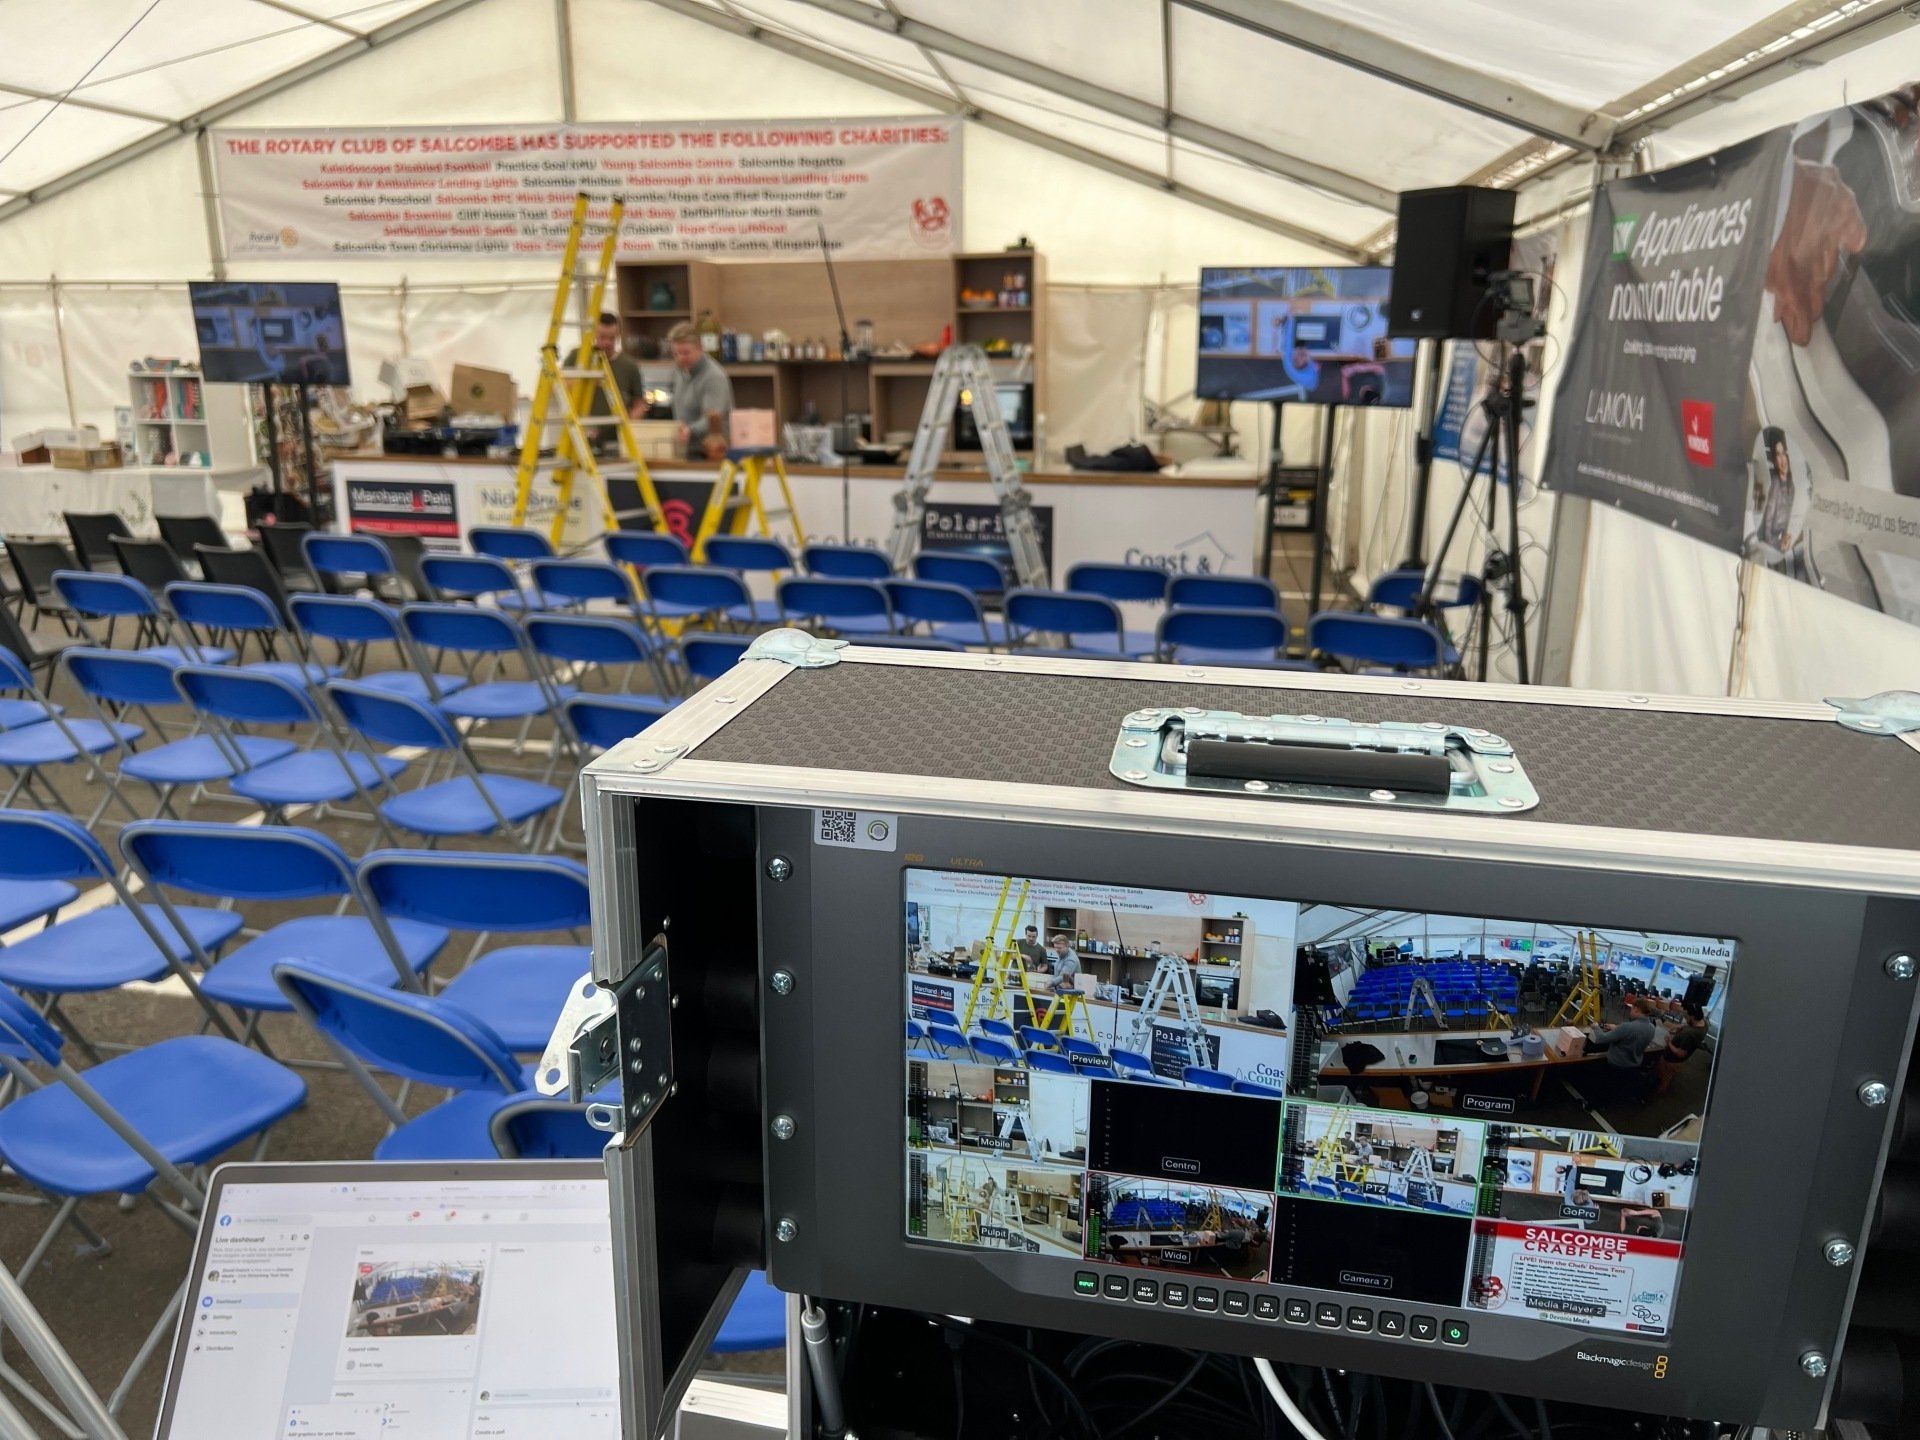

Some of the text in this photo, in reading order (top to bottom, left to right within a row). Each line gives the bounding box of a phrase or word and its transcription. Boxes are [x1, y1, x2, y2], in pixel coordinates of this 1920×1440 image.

[226, 138, 260, 155] THE
[265, 138, 337, 155] ROTARY
[341, 137, 388, 154] CLUB
[391, 136, 417, 154] OF
[420, 135, 517, 153] SALCOMBE
[521, 133, 560, 151] HAS
[565, 131, 675, 151] SUPPORTED
[680, 131, 715, 149] THE
[719, 129, 835, 149] FOLLOWING
[1630, 197, 1752, 268] Appliances
[1585, 388, 1645, 433] LAMONA
[1125, 546, 1189, 575] Coast
[950, 856, 985, 868] ULTRA
[1662, 942, 1731, 958] Devonia Media
[1071, 1053, 1111, 1067] Preview
[1466, 1097, 1512, 1111] Program
[980, 1137, 1012, 1150] Mobile
[1164, 1159, 1198, 1172] Centre
[1364, 1183, 1387, 1195] PTZ
[1562, 1206, 1597, 1219] GoPro
[980, 1226, 1008, 1239] Pulpit
[1524, 1227, 1629, 1252] SALCOMBE
[1163, 1249, 1189, 1262] Wide
[1523, 1239, 1627, 1263] CRABFEST
[1539, 1258, 1555, 1266] from
[1556, 1259, 1567, 1267] the
[1588, 1264, 1610, 1272] Demo
[1611, 1266, 1627, 1275] Tent
[1342, 1273, 1390, 1287] Camera 7
[1137, 1290, 1154, 1298] DELAY
[1197, 1296, 1214, 1304] ZOOM
[1229, 1300, 1243, 1308] PEAK
[1528, 1298, 1605, 1316] Media Player 2
[1572, 1315, 1591, 1325] Media
